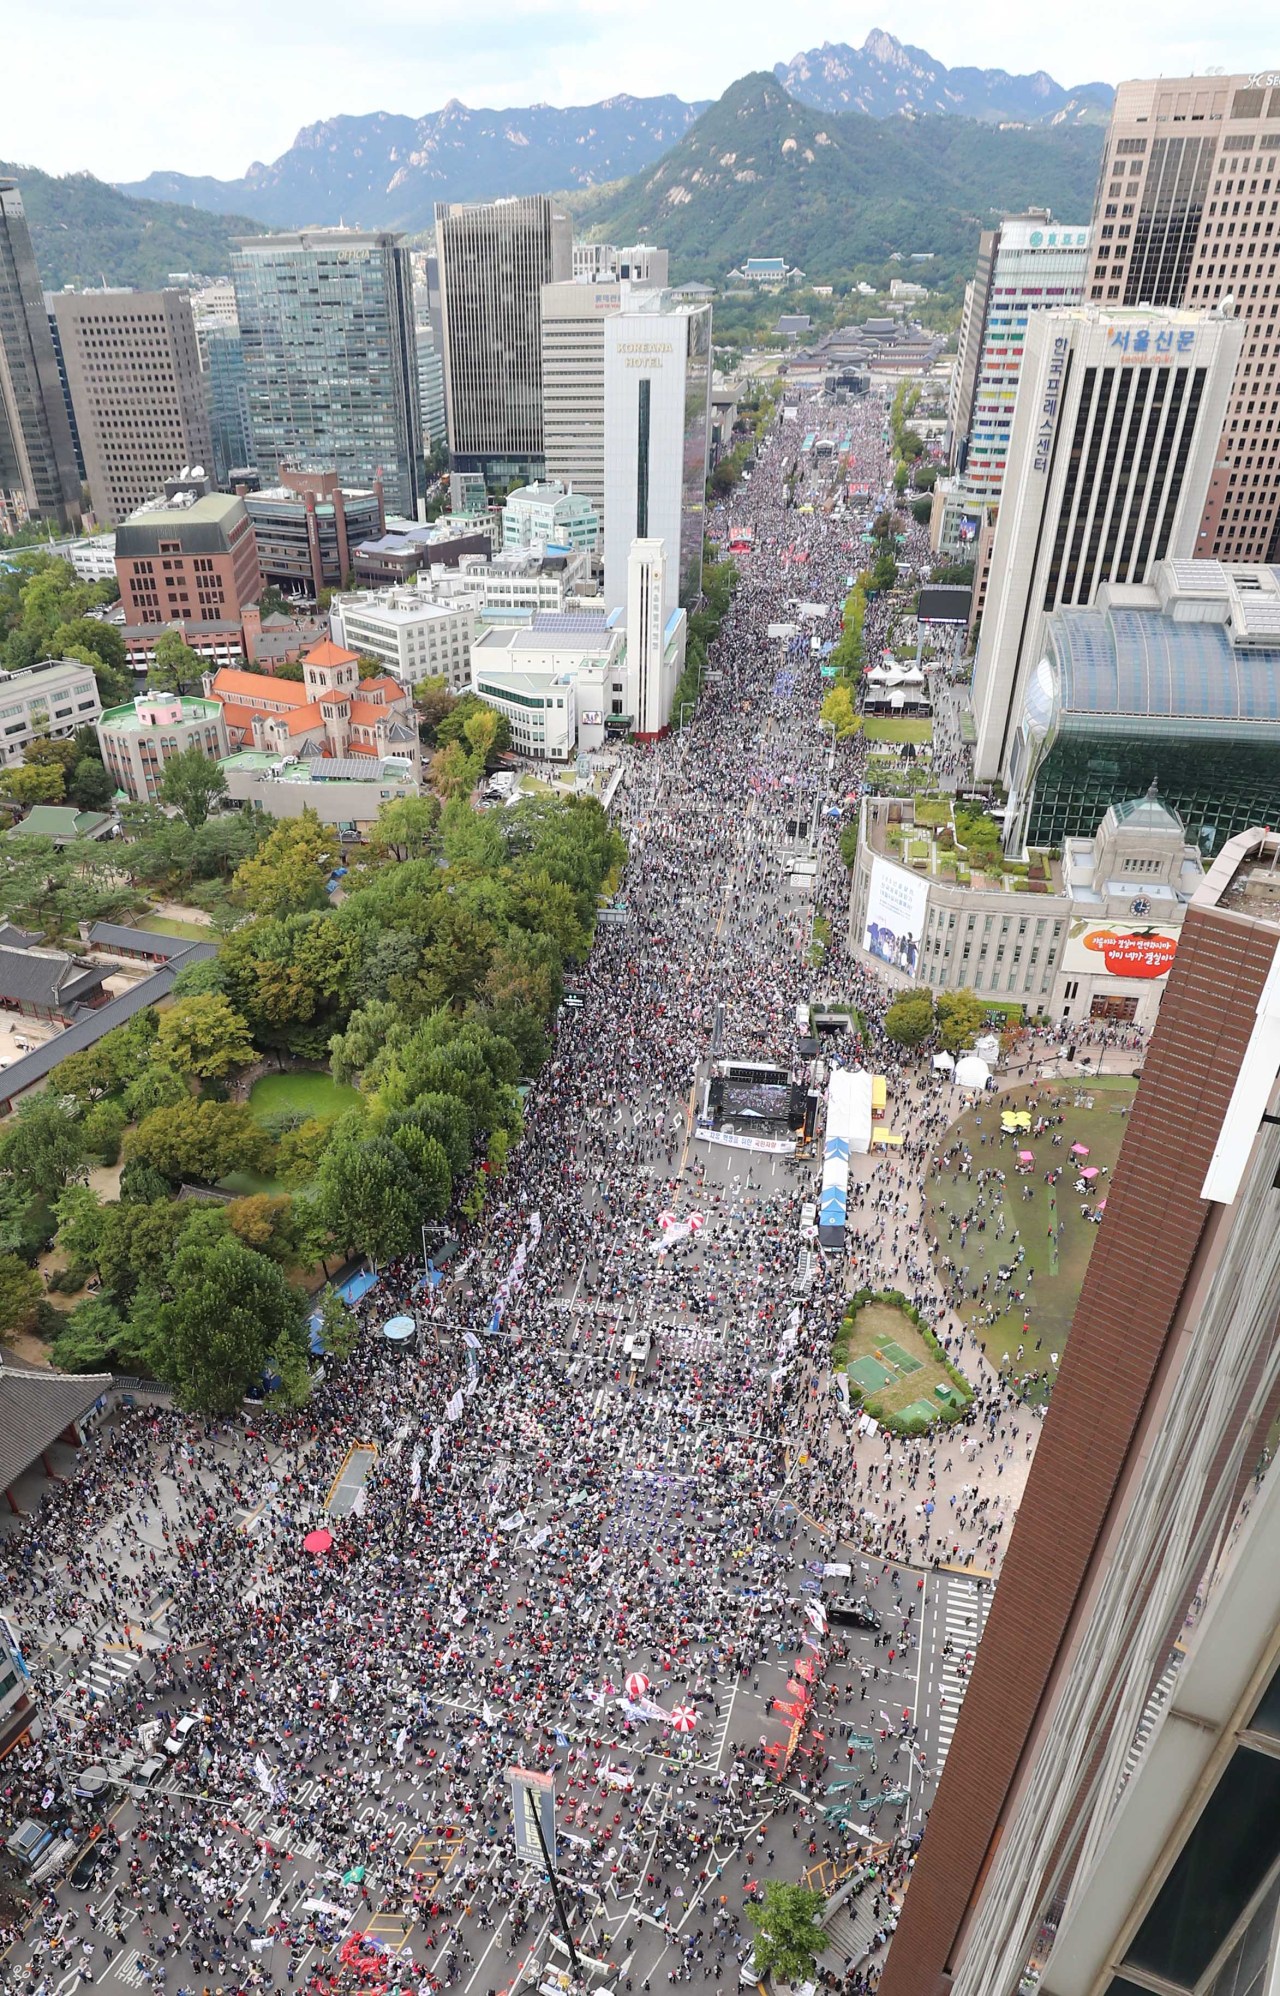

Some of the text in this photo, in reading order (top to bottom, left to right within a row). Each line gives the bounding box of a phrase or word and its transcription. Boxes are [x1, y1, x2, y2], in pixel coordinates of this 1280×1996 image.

[1266, 74, 1280, 87] SE
[1111, 329, 1195, 352] 서울신문
[616, 343, 673, 354] KOREANA
[625, 358, 663, 368] HOTEL
[1033, 337, 1068, 473] 한국프레스센터
[1108, 950, 1123, 960] 이미
